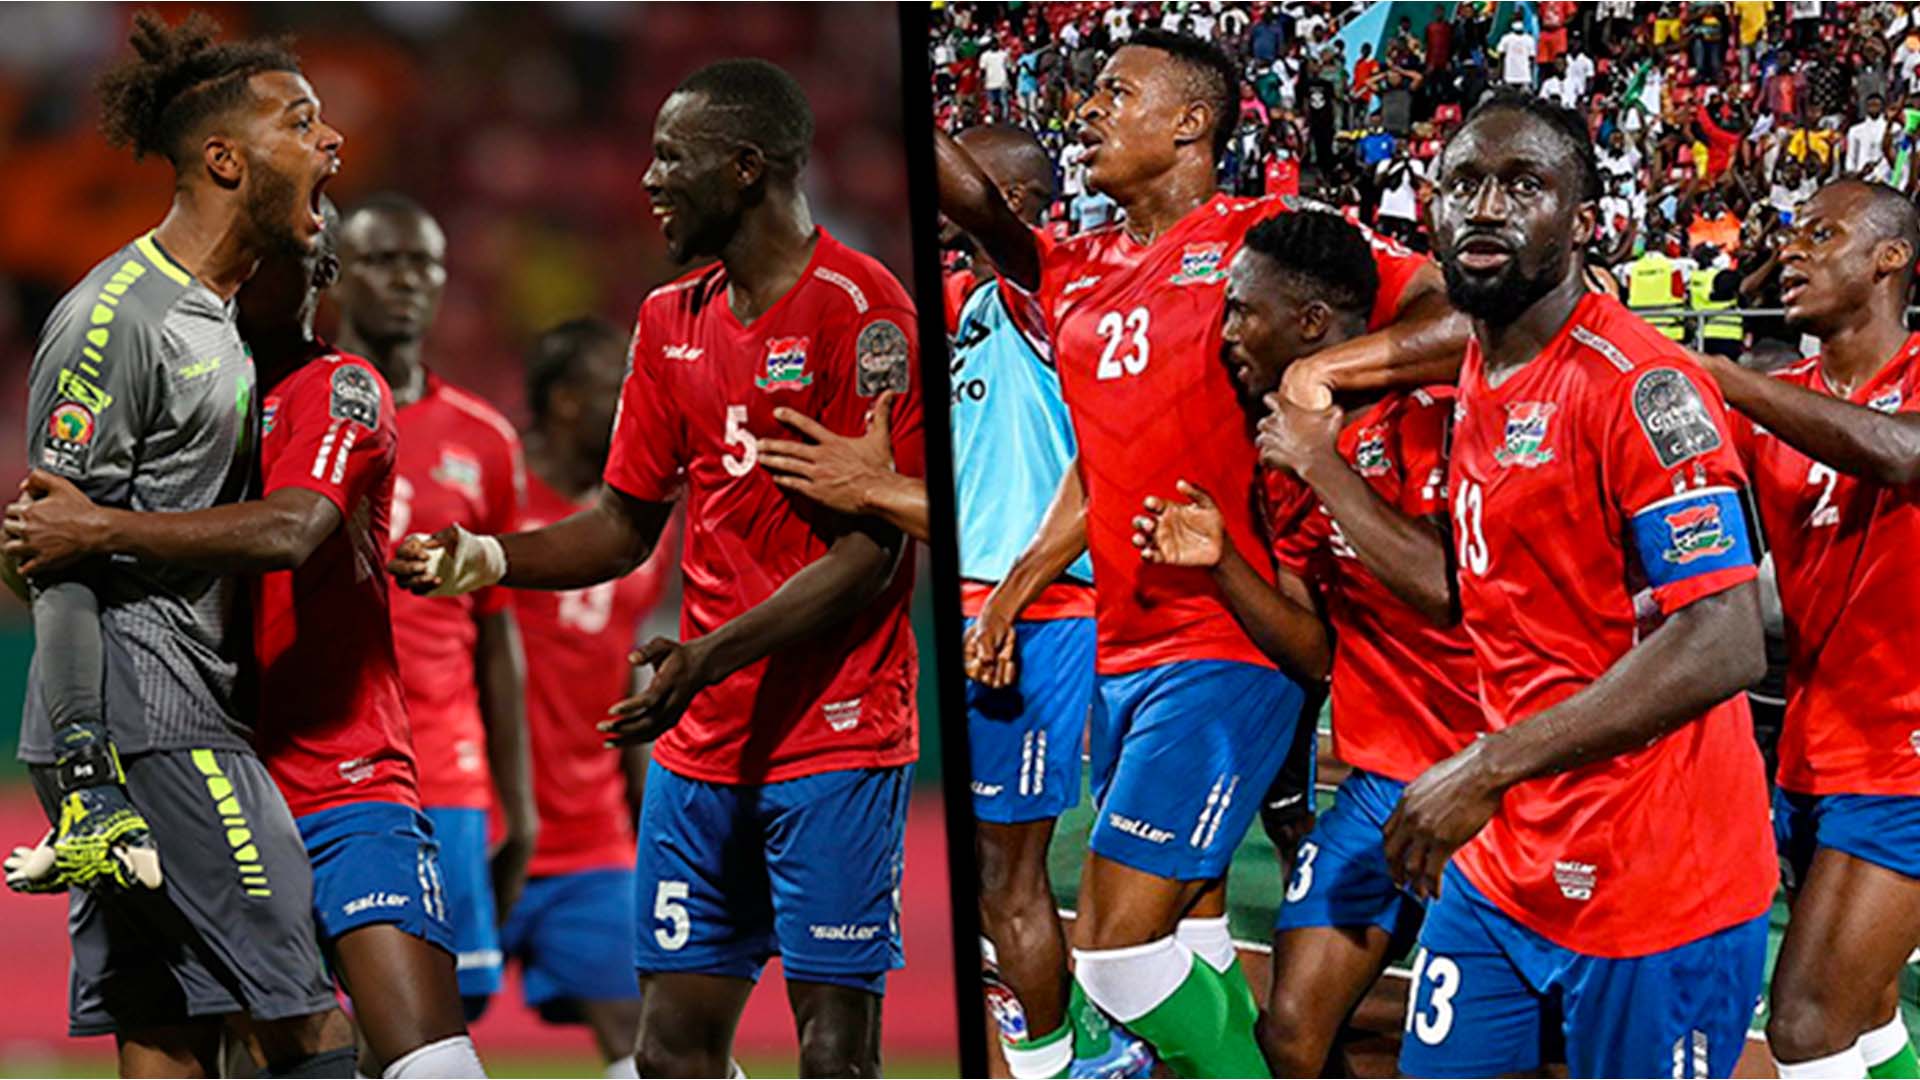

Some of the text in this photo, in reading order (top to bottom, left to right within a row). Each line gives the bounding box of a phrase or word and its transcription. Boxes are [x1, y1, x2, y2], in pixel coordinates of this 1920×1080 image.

[1096, 306, 1150, 380] 23
[722, 405, 759, 477] 5
[1455, 478, 1490, 577] 13
[1807, 461, 1840, 528] 2
[1109, 813, 1176, 844] saller
[343, 891, 411, 915] saller
[1285, 841, 1319, 902] 3
[653, 879, 691, 951] 5
[809, 924, 881, 941] saller
[1405, 945, 1461, 1046] 13
